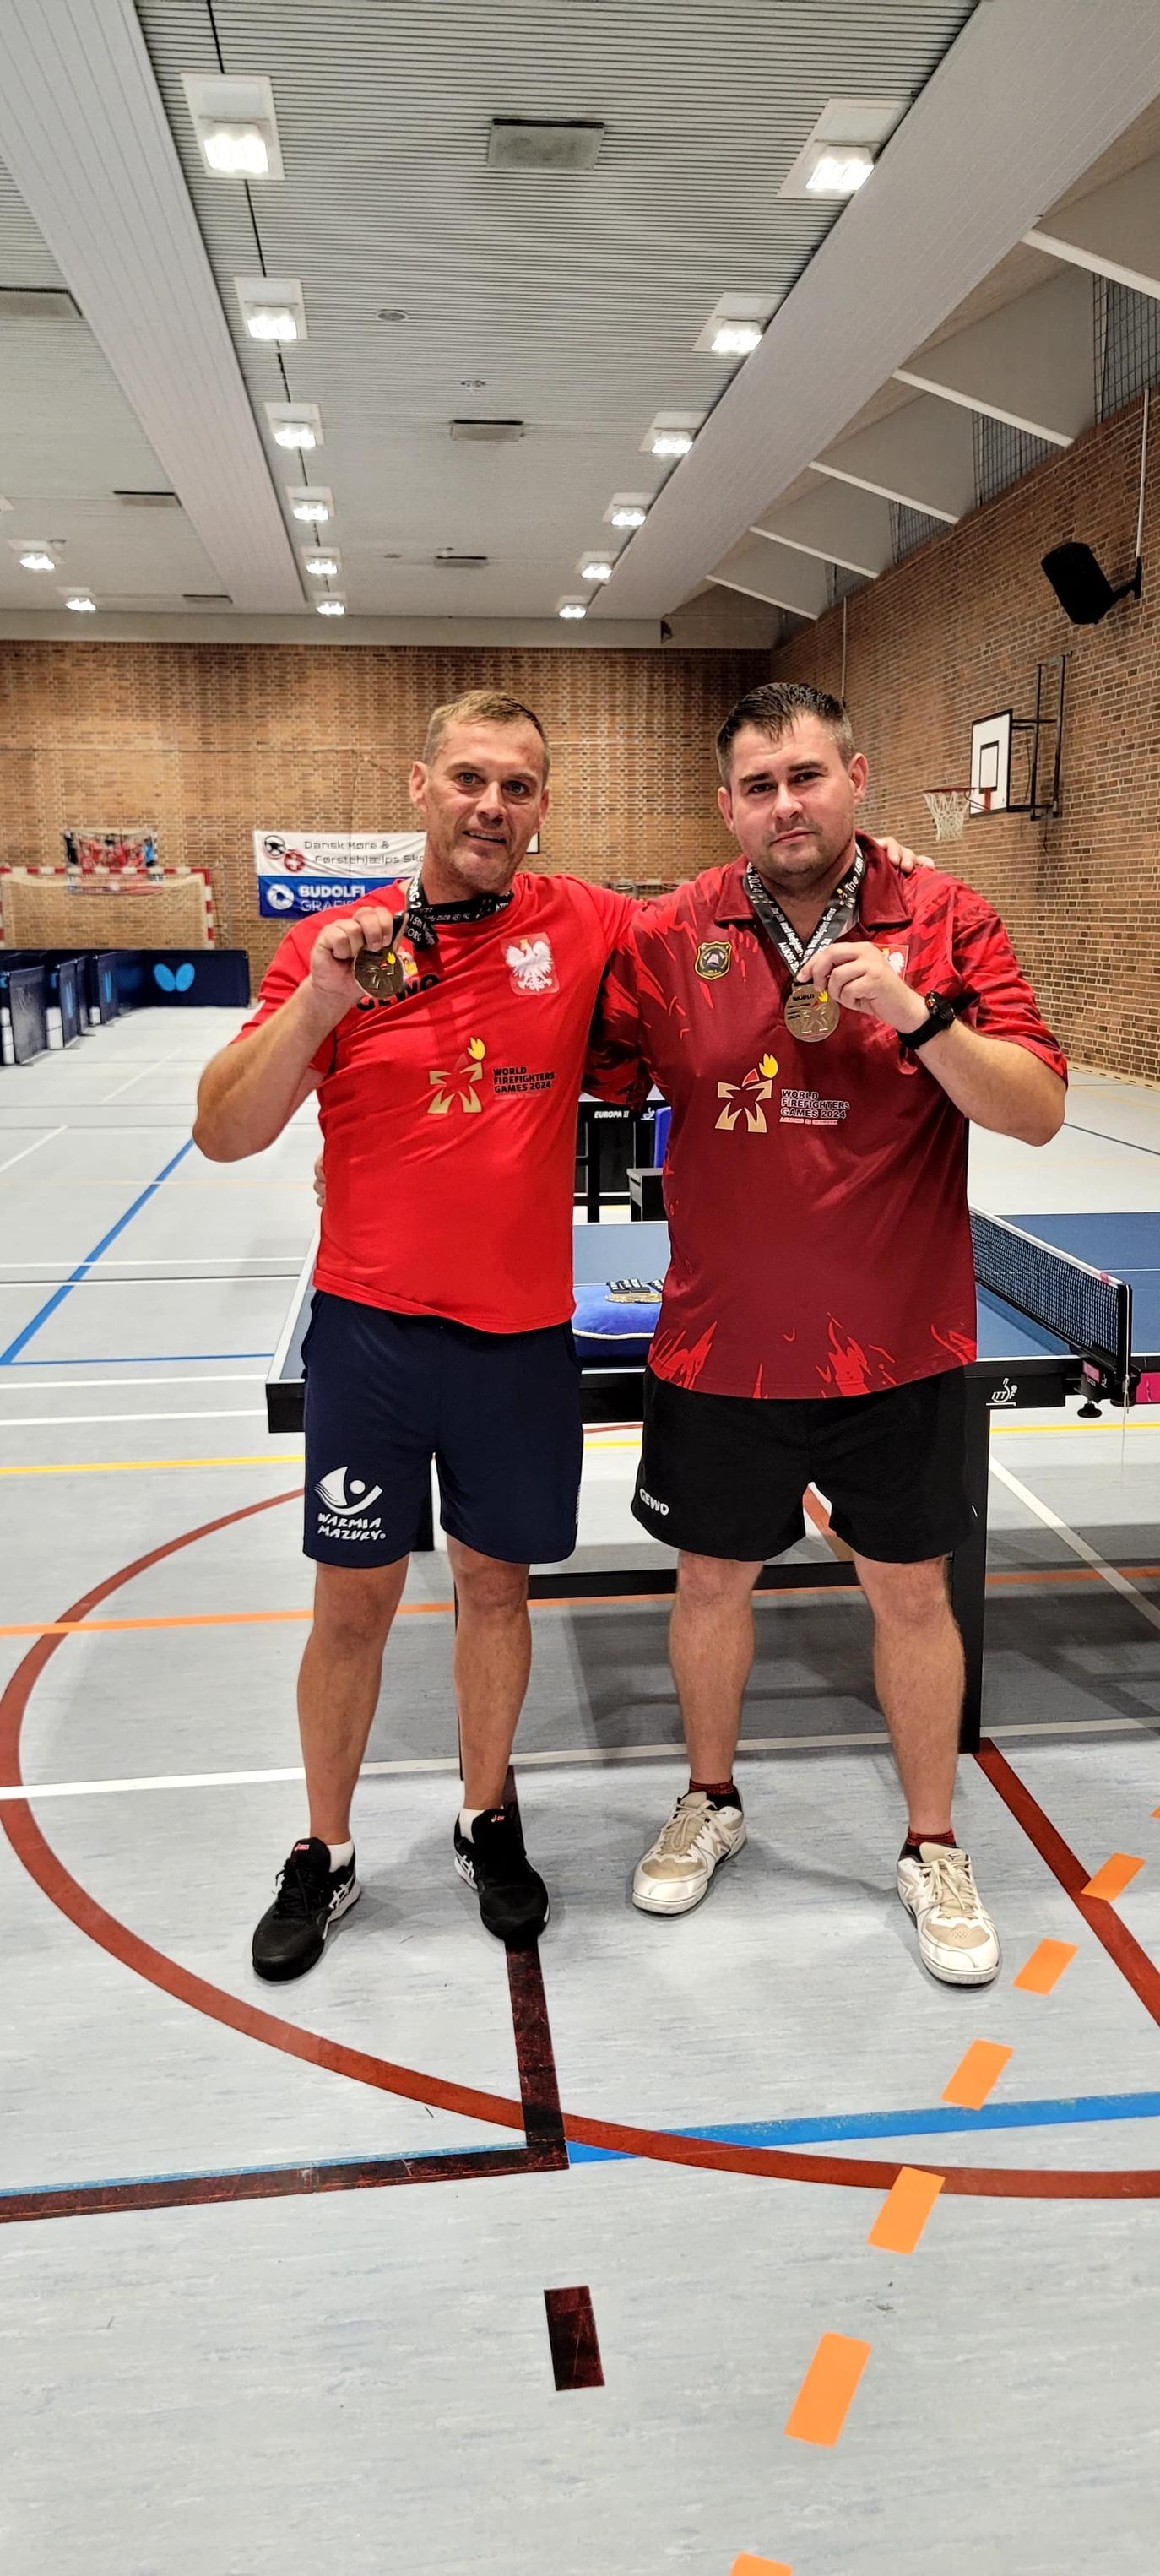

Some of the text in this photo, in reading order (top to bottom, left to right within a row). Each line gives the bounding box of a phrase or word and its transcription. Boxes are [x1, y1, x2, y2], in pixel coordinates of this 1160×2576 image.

[304, 841, 389, 850] Dansk Køre &
[315, 854, 400, 866] Førstehjælps
[747, 873, 763, 894] 2024
[844, 876, 859, 893] The
[298, 885, 366, 898] BUDOLFI
[493, 1066, 527, 1076] WORLD
[494, 1071, 556, 1085] FIREFIGHTERS
[494, 1081, 551, 1093] GAMES 2024
[781, 1089, 819, 1100] WORLD
[781, 1098, 850, 1110] FIREFIGHTERS
[594, 1110, 622, 1119] EUROPA
[780, 1107, 847, 1119] GAMES 2024
[639, 1488, 669, 1516] GEWO
[317, 1512, 382, 1529] WARMIA
